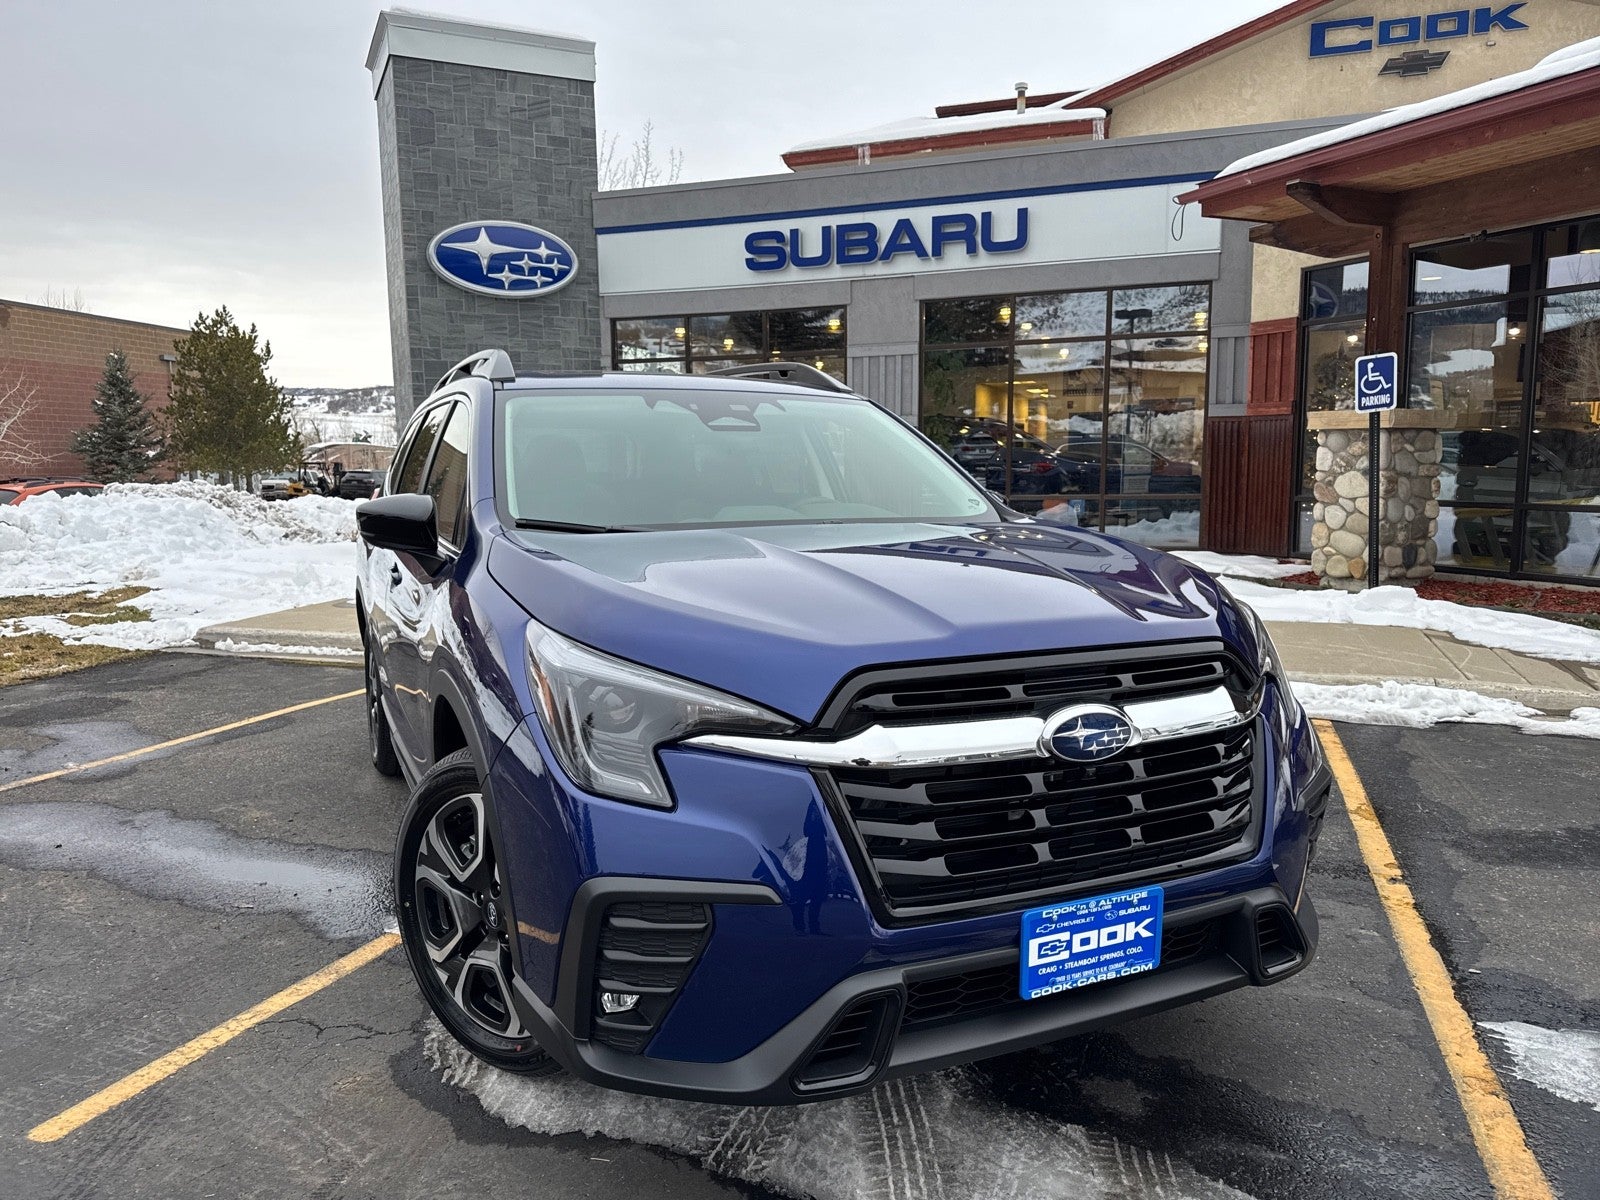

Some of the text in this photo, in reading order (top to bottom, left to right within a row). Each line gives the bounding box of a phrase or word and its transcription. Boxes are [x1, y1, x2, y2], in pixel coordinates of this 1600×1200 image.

[1310, 3, 1529, 58] COOK
[744, 207, 1029, 271] SUBARU
[1361, 394, 1391, 407] PARKING
[1099, 891, 1149, 906] ALTITUDE
[1118, 905, 1151, 916] SUBARU
[1057, 916, 1095, 928] CHEVROLET
[1028, 917, 1155, 967] COOK
[1038, 965, 1057, 975] CRAIG
[1064, 957, 1098, 969] STEAMBOAT
[1031, 963, 1153, 999] COOK-CARS.COM
